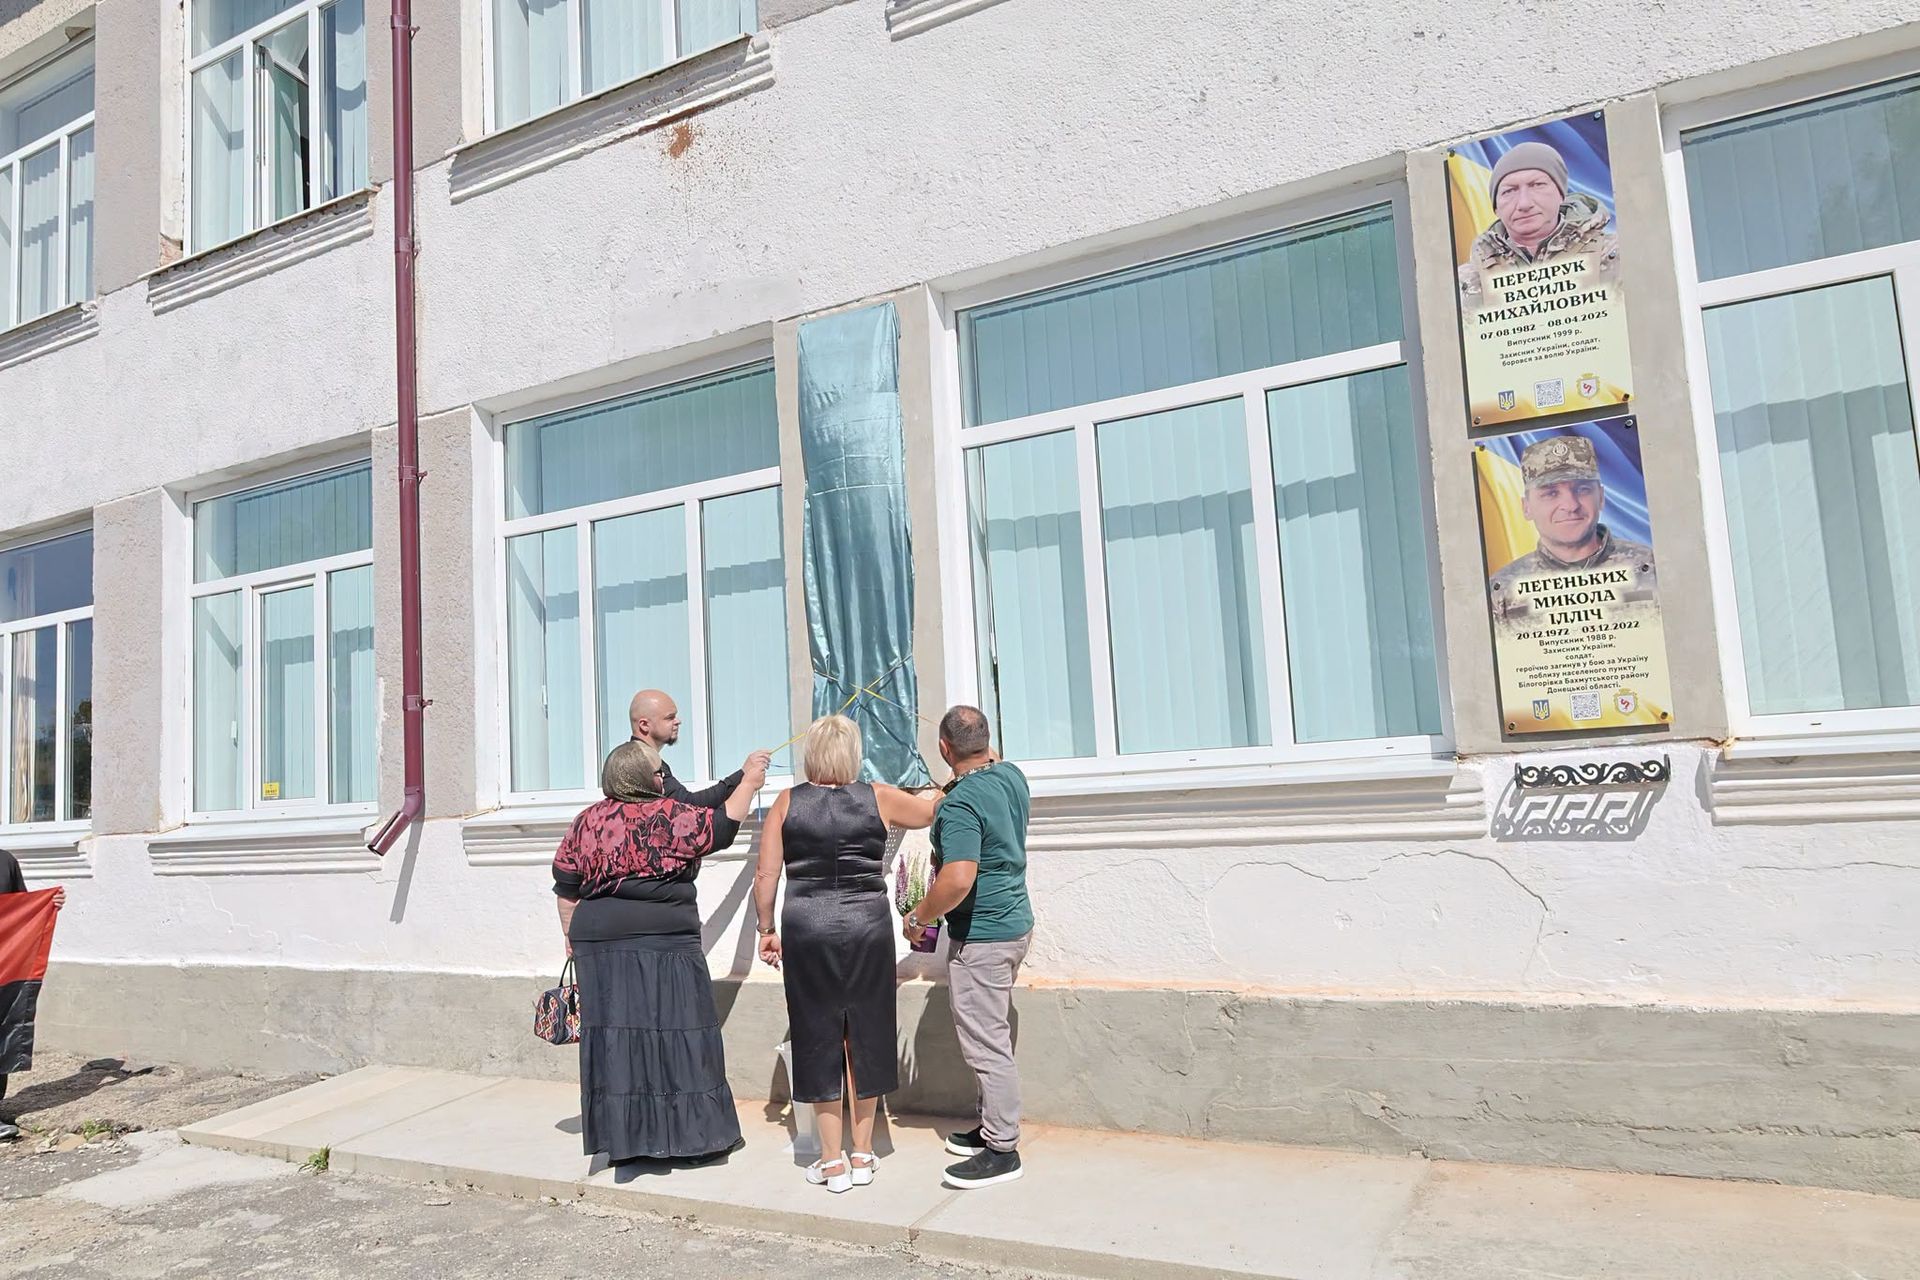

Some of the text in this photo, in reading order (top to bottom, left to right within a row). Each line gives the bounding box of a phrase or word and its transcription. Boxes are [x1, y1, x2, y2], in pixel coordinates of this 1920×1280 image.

[1492, 260, 1586, 289] ПЕРЕДРУК
[1504, 280, 1577, 303] ВАСИЛЬ
[1478, 290, 1608, 324] МИХАЙЛОВИЧ
[1480, 323, 1536, 340] 07.08.1982
[1547, 310, 1608, 328] 08.04.2025
[1507, 334, 1551, 347] Випускник
[1553, 329, 1573, 338] 1999
[1500, 349, 1535, 359] Захисник
[1502, 357, 1532, 367] боровся
[1544, 351, 1564, 359] волю
[1518, 569, 1628, 595] ЛЕГЕНЬКИХ
[1533, 589, 1616, 609] МИКОЛА
[1548, 608, 1603, 625] ІЛЛІЧ
[1516, 628, 1569, 640] 20.12.1972
[1581, 621, 1640, 634] 03.12.2022
[1539, 637, 1584, 647] Випускник
[1587, 633, 1607, 641] 1988
[1543, 646, 1580, 654] Захисник
[1516, 664, 1548, 673] героїчно
[1550, 661, 1581, 670] загинув
[1617, 655, 1649, 663] Україну
[1529, 665, 1636, 680] поблизу населеного пункту
[1518, 671, 1649, 689] Білогорівка Бахмутського району
[1547, 684, 1588, 694] Донецької
